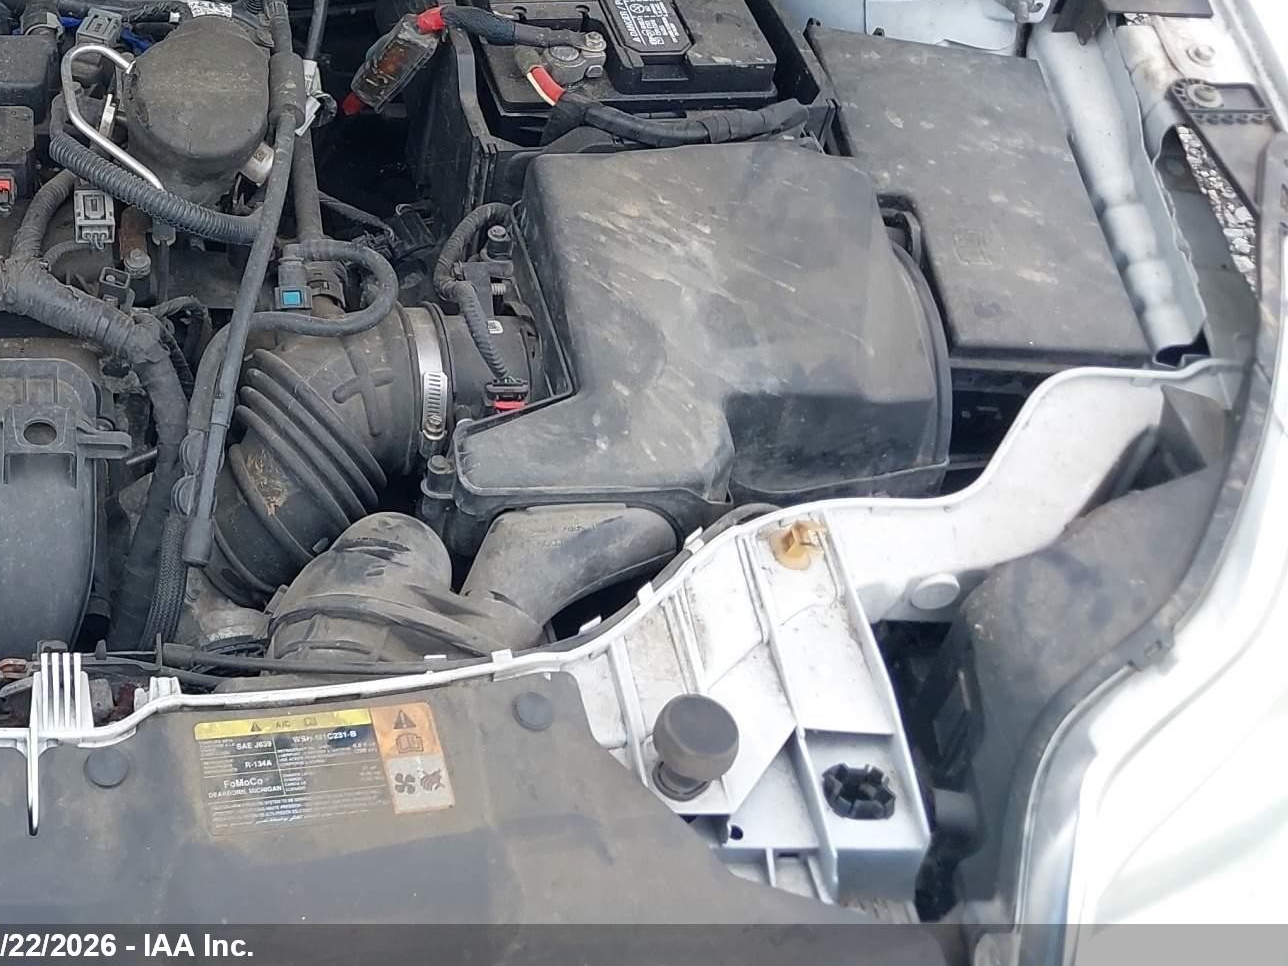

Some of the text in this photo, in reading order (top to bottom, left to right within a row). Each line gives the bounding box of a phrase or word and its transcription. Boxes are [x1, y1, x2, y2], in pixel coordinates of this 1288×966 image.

[619, 10, 638, 37] DANGER
[235, 741, 253, 751] SAE
[244, 758, 273, 770] R-134A
[223, 777, 264, 789] FoMoCo
